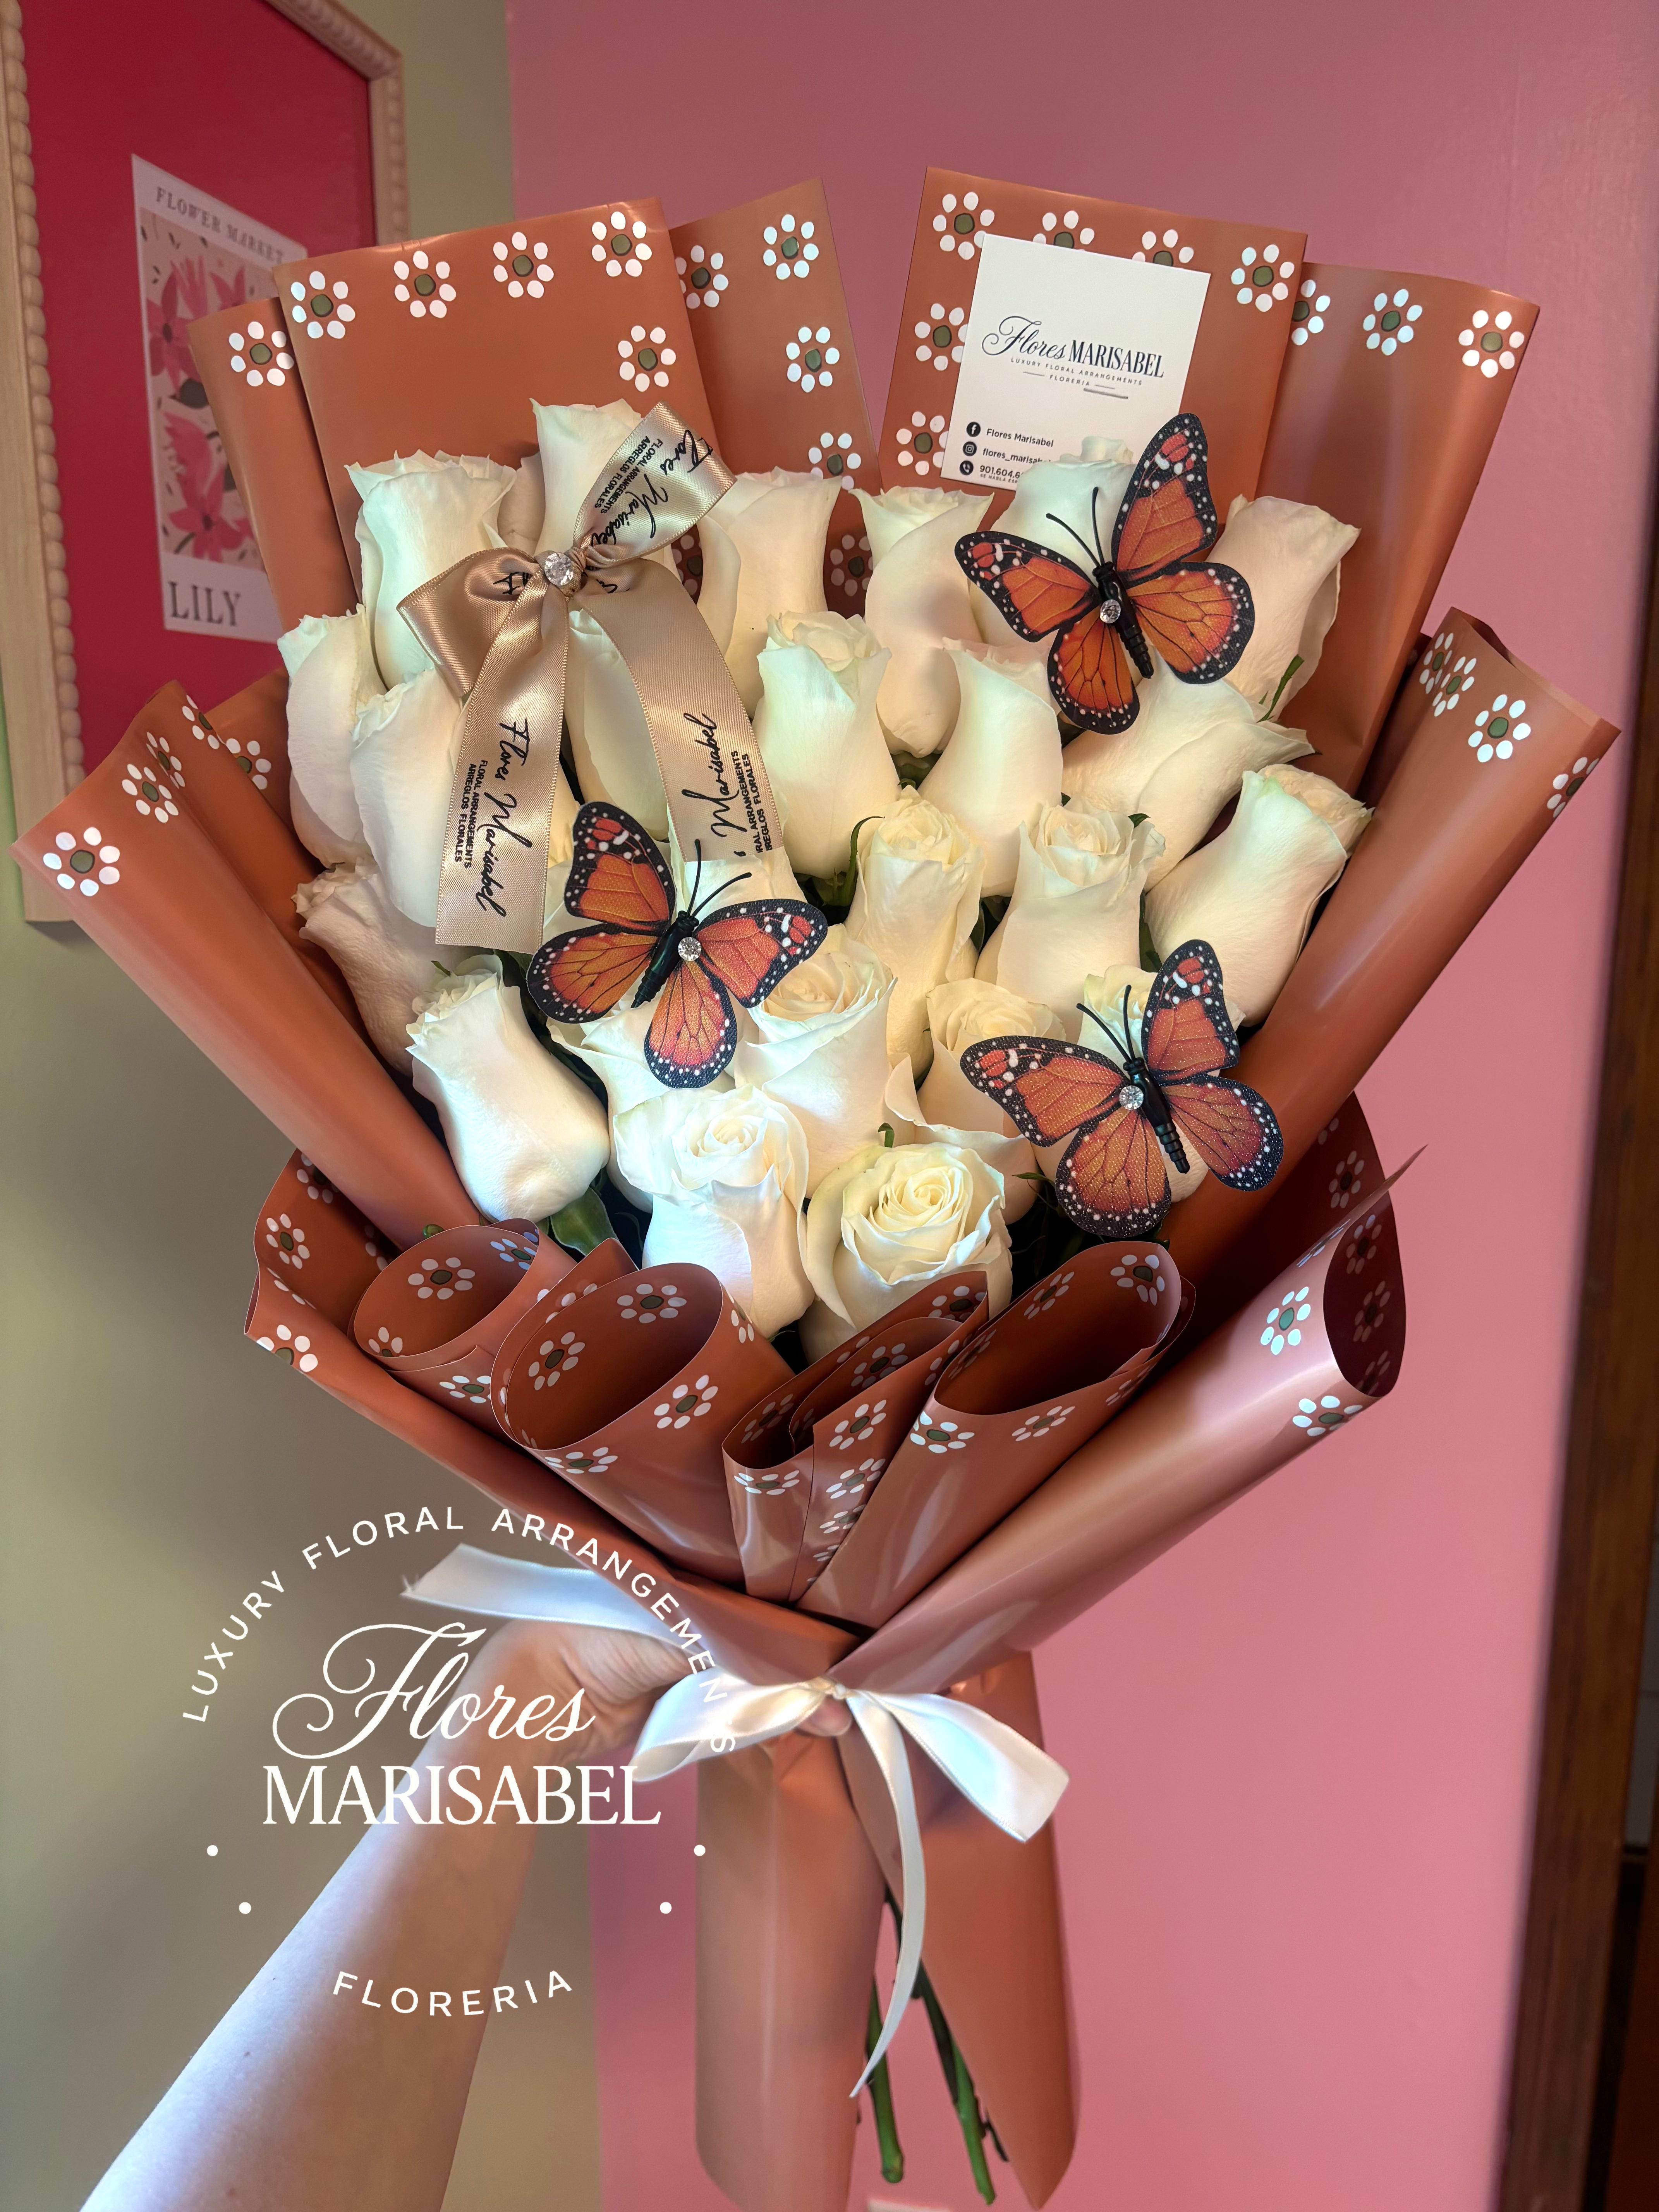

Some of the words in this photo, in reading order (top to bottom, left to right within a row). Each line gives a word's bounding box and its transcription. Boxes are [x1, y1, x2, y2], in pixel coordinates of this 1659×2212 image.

[156, 186, 221, 233] FLOWER
[227, 223, 283, 264] MARKET
[982, 316, 1066, 360] Flores
[1068, 340, 1164, 378] MARISABEL
[1011, 358, 1041, 367] LUXURY
[1046, 364, 1074, 374] FLORAL
[1079, 370, 1142, 386] ARRANGEMENTS
[1049, 374, 1089, 386] FLORERIA
[620, 436, 651, 473] ARREGLOS
[638, 438, 663, 467] FLORAL
[982, 448, 1051, 464] flores_marisa
[986, 428, 1012, 440] Flores
[1014, 433, 1054, 447] Marisabel
[594, 473, 622, 509] FLORALES
[600, 466, 640, 514] ARRANGEMENTS
[980, 465, 1023, 479] 901.604.6
[168, 580, 241, 627] LILY
[495, 718, 531, 781] Flores
[461, 763, 477, 810] ARREGLOS
[474, 760, 488, 790] FLORAL
[681, 713, 748, 838] Marisabel
[731, 750, 758, 830] ARRANGEMENTS
[742, 754, 761, 805] FLORALES
[455, 814, 467, 862] FLORALES
[464, 792, 480, 868] ARRANGEMENTS
[475, 792, 533, 917] Marisabel
